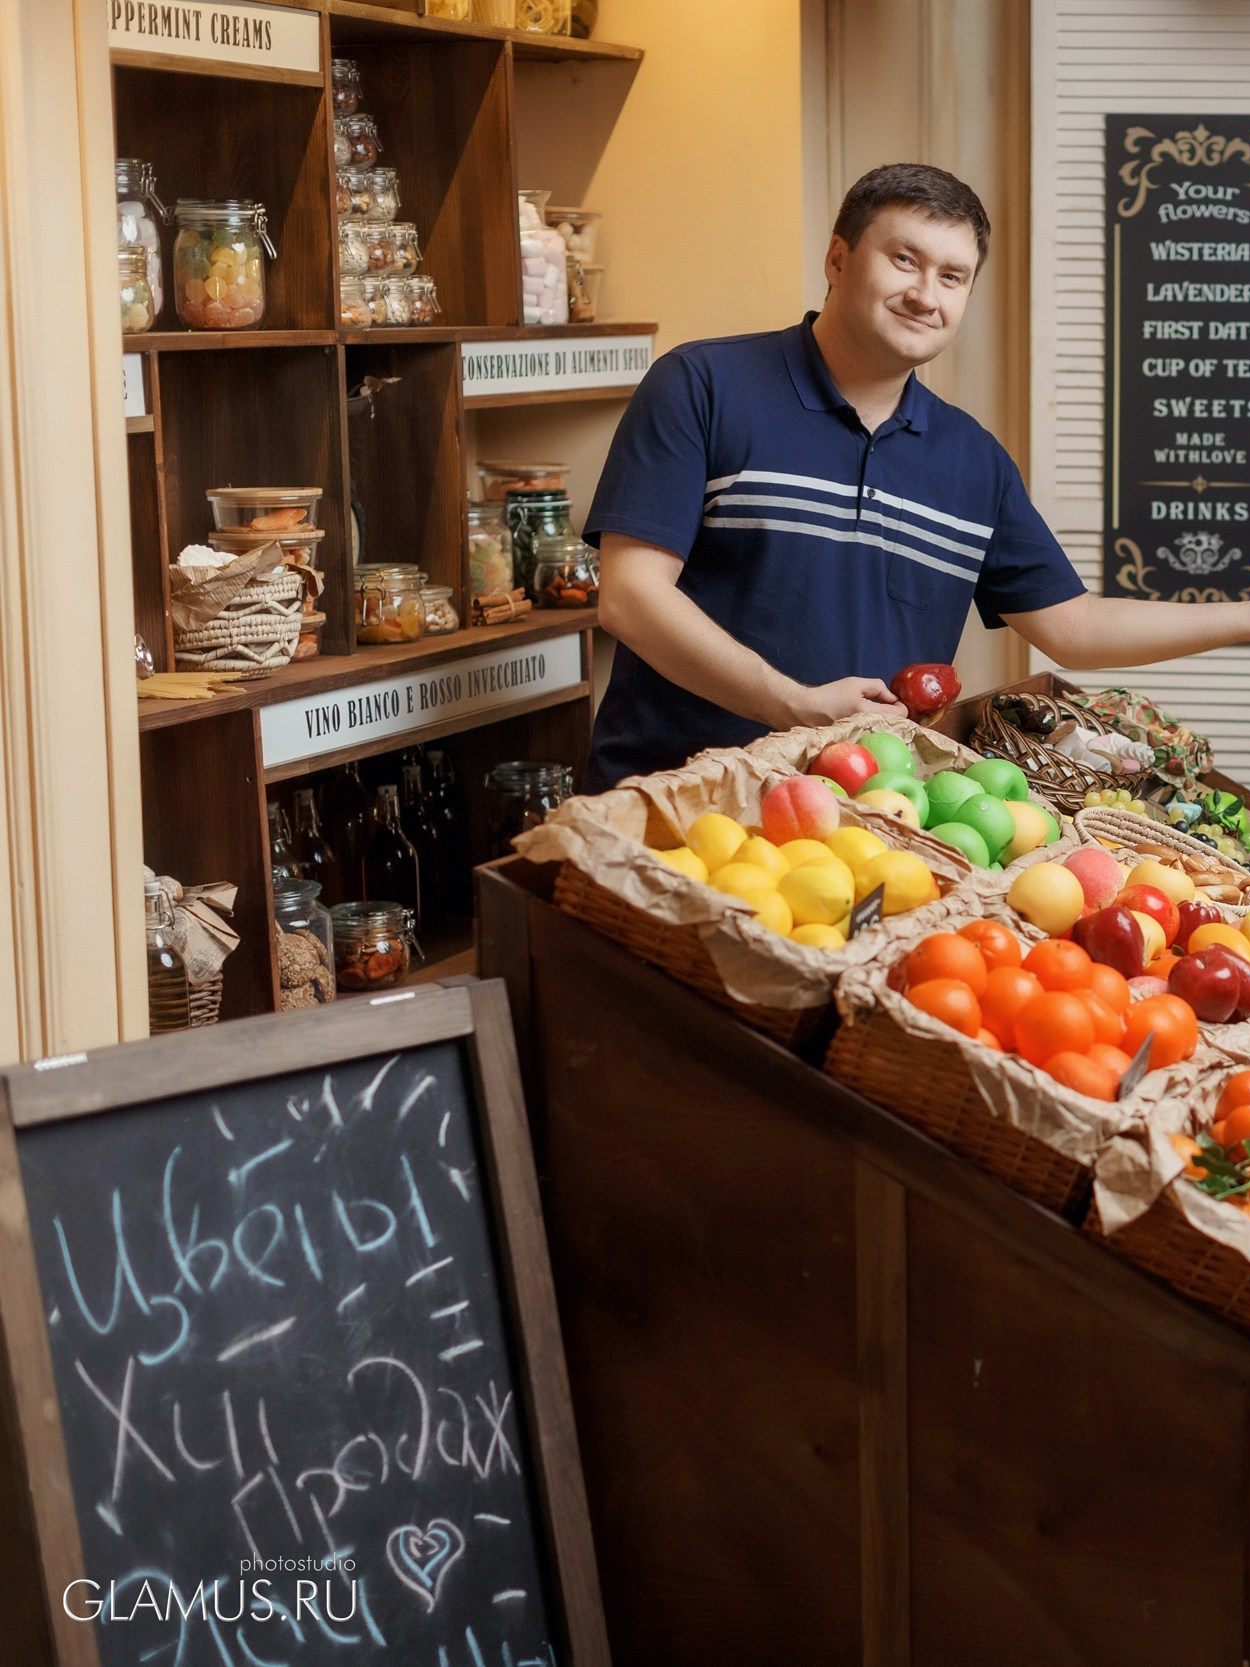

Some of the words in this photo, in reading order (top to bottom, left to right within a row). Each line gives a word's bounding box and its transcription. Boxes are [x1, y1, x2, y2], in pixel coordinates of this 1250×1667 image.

[106, 0, 202, 41] PPERMINT
[210, 13, 272, 51] CREAMS
[1169, 181, 1241, 201] Your
[1149, 240, 1250, 261] WISTERIA
[1143, 320, 1204, 340] FIRST
[461, 351, 550, 381] CONSERVAZIONE
[555, 351, 567, 375] DI
[571, 348, 619, 374] ALIMENTI
[1142, 358, 1186, 378] CUP
[1188, 358, 1218, 378] OF
[1175, 432, 1226, 446] MADE
[1151, 500, 1250, 521] DRINKS
[305, 703, 341, 739] VINO
[347, 688, 400, 729] BIANCO
[406, 686, 414, 714] E
[419, 674, 462, 710] ROSSO
[467, 653, 546, 698] INVECCHIATO
